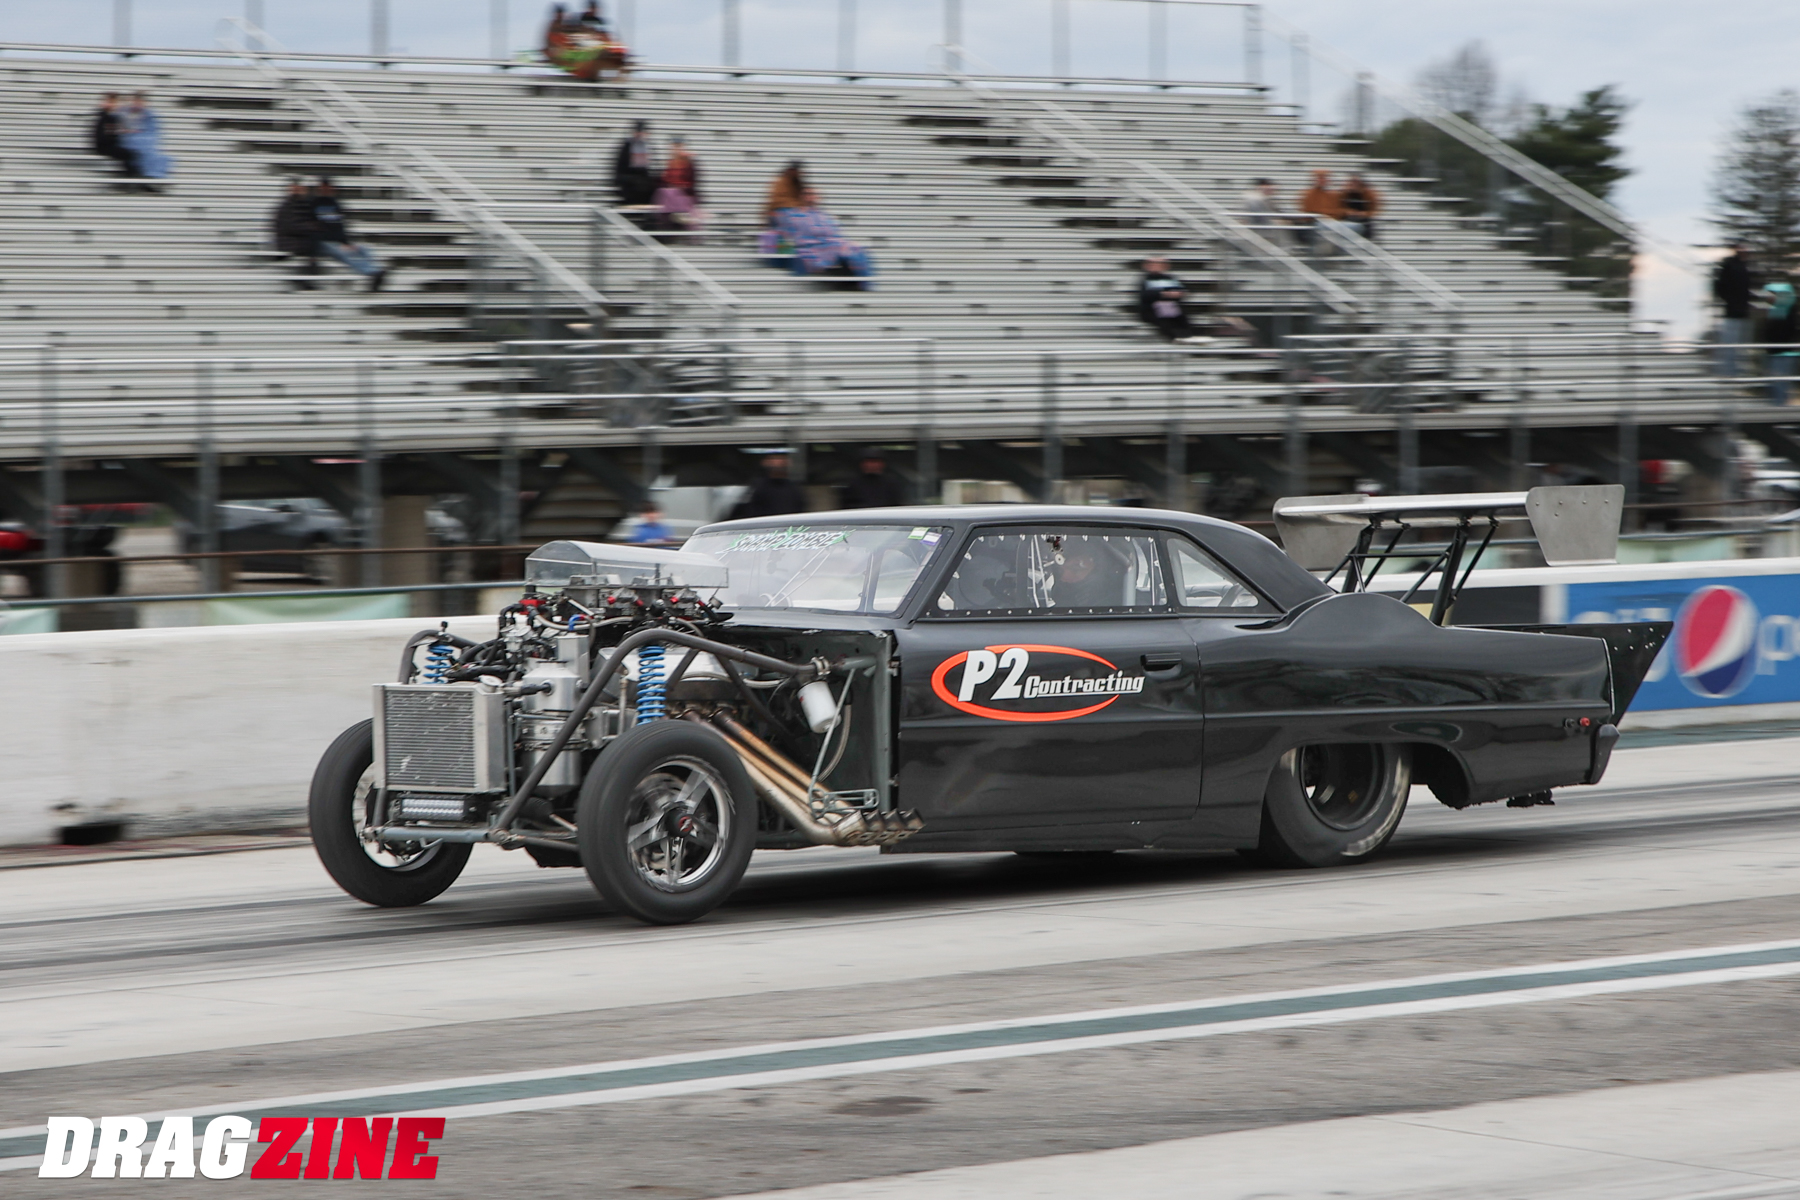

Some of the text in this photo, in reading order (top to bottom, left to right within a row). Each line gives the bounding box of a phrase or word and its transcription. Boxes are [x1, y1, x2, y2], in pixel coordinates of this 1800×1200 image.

[772, 532, 844, 550] ZOMBIE
[957, 647, 1145, 702] P2 Contracting
